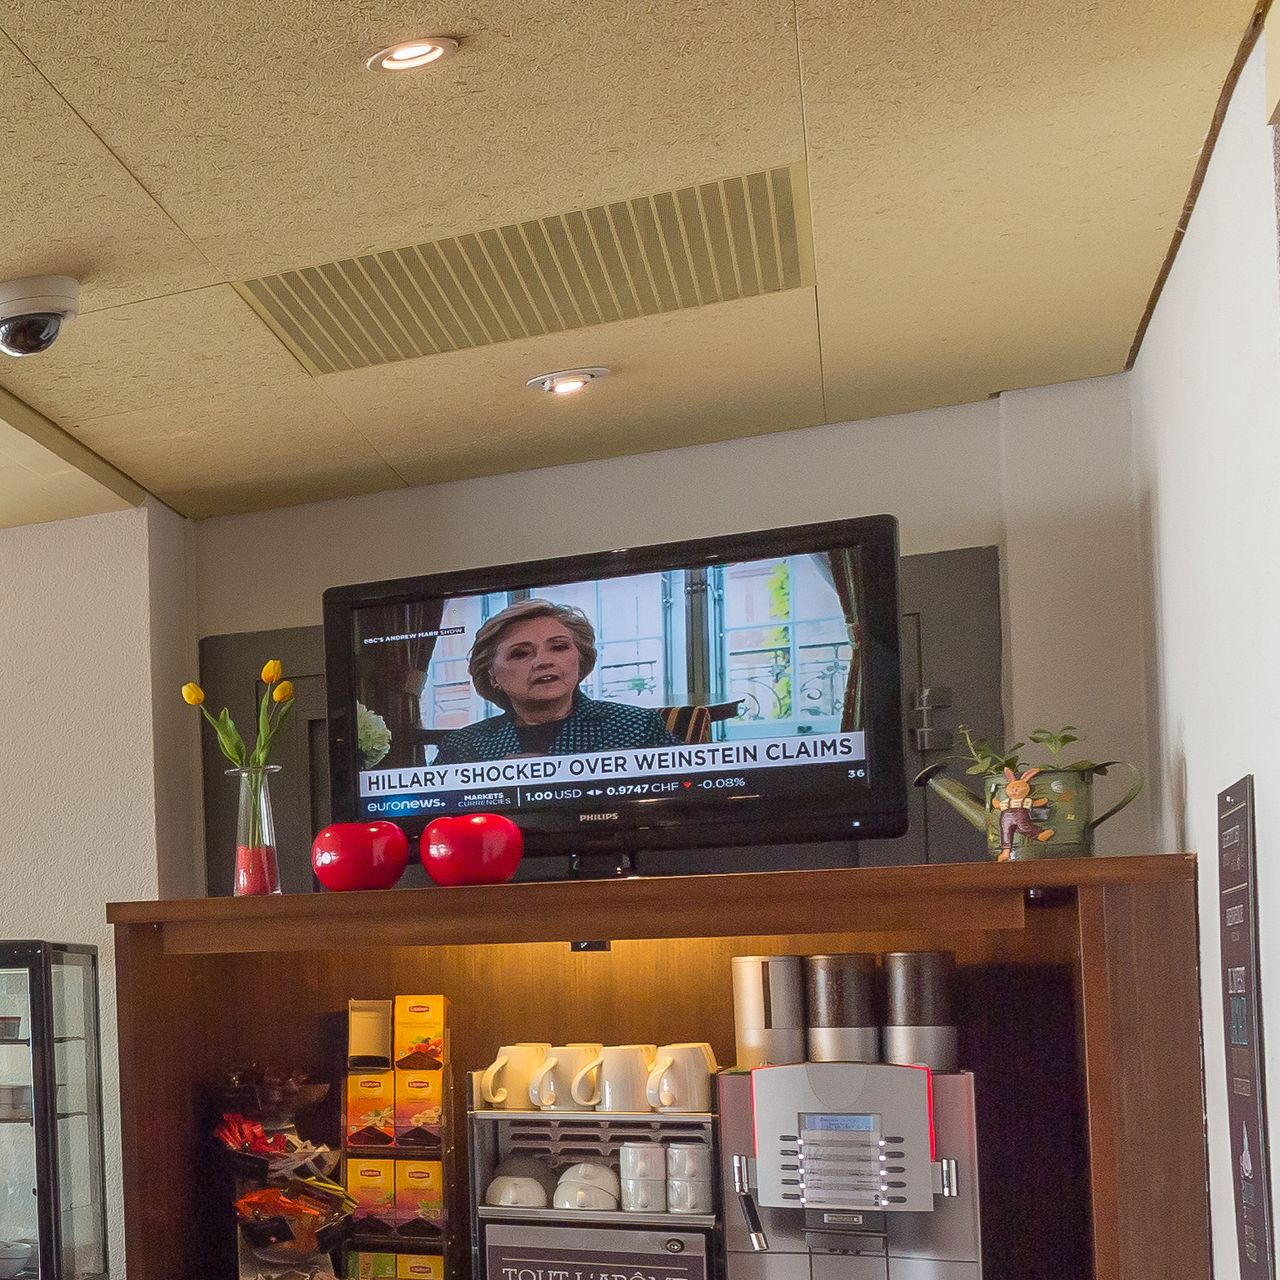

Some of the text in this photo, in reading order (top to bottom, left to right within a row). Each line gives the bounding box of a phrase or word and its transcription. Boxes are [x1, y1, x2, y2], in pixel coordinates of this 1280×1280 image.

[385, 633, 417, 642] ANDREW
[440, 628, 463, 636] SHOW
[368, 738, 852, 791] HILLARY 'SHOCKED' OVER WEINSTEIN CLAIMS
[848, 769, 865, 778] 36
[526, 777, 746, 802] 1.00 USD 0.9747 CHF -0.08%
[464, 792, 504, 801] MARKETS
[458, 798, 511, 808] CURRENCIES
[579, 812, 618, 822] PHILIPS
